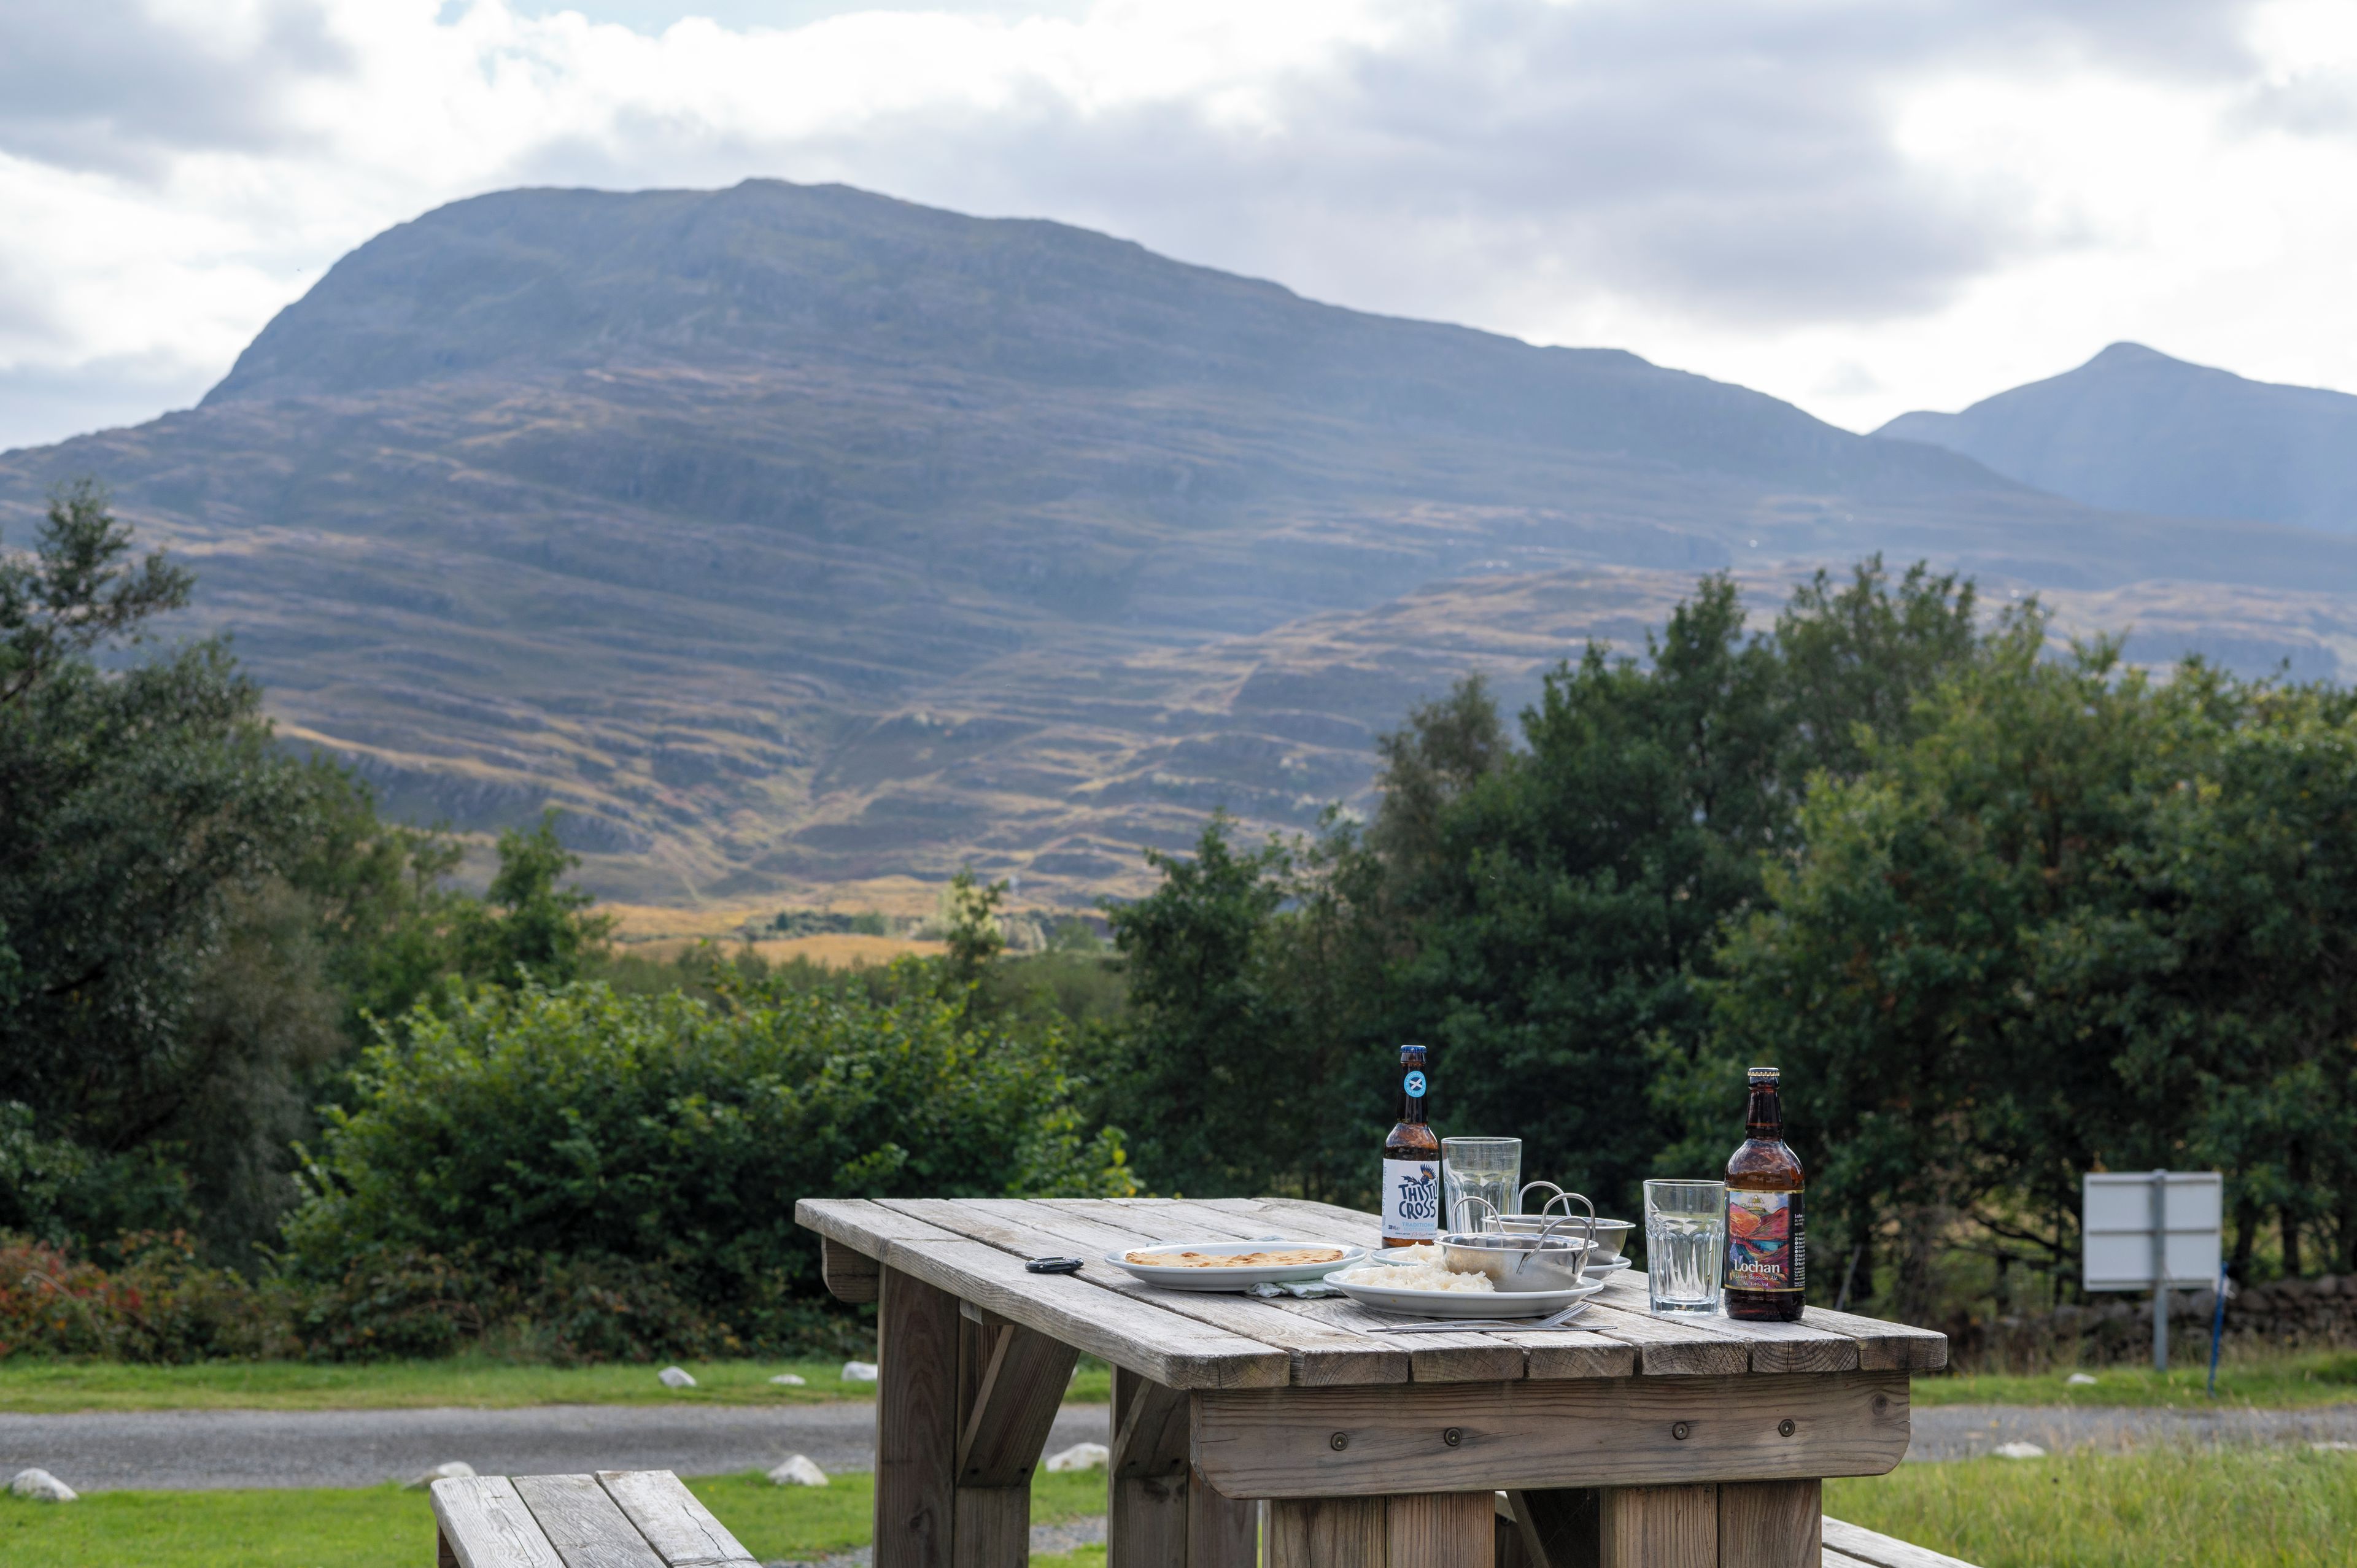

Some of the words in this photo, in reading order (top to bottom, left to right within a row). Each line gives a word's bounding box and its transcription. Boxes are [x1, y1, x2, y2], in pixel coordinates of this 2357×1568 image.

[1398, 1177, 1438, 1202] THISTLY
[1399, 1200, 1436, 1219] CROSS
[1734, 1259, 1780, 1273] Lochan
